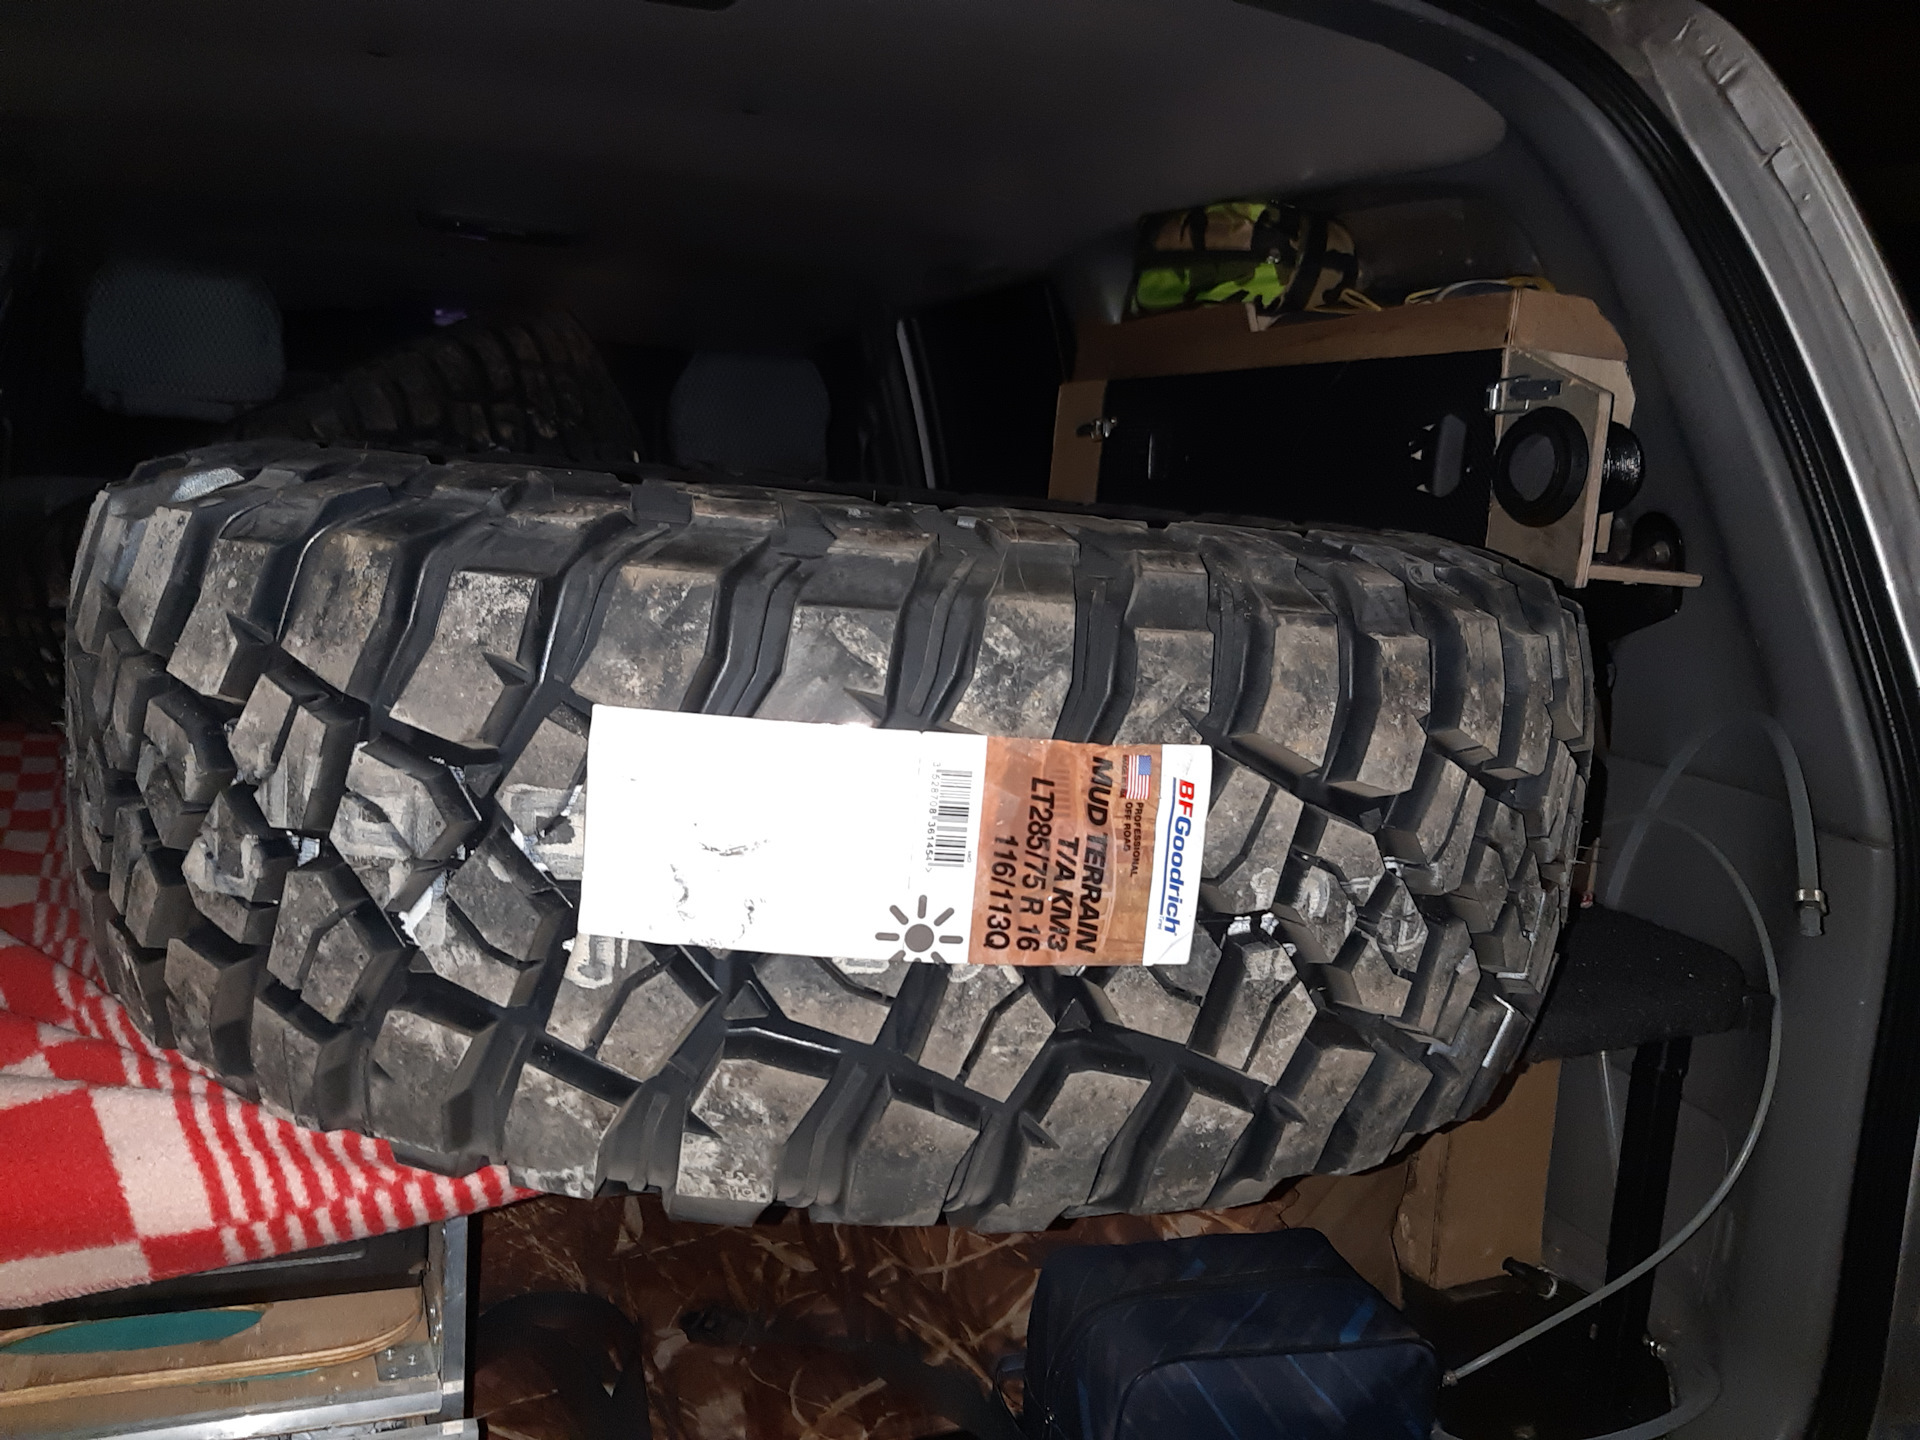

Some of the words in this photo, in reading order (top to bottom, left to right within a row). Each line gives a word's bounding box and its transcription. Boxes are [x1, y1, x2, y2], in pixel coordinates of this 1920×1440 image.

[1086, 756, 1114, 826] MUD
[1124, 802, 1133, 820] OFF
[1022, 777, 1055, 890] LT285/75
[1051, 836, 1080, 883] T/A
[1123, 822, 1132, 852] ROAD
[1129, 802, 1144, 878] PROFESSIONAL
[1164, 779, 1195, 935] BFGoodrich
[983, 834, 1019, 951] 116/113Q
[1019, 896, 1045, 916] R
[1047, 887, 1074, 953] KM3
[1075, 833, 1109, 954] TERRAIN
[1016, 925, 1041, 953] 16
